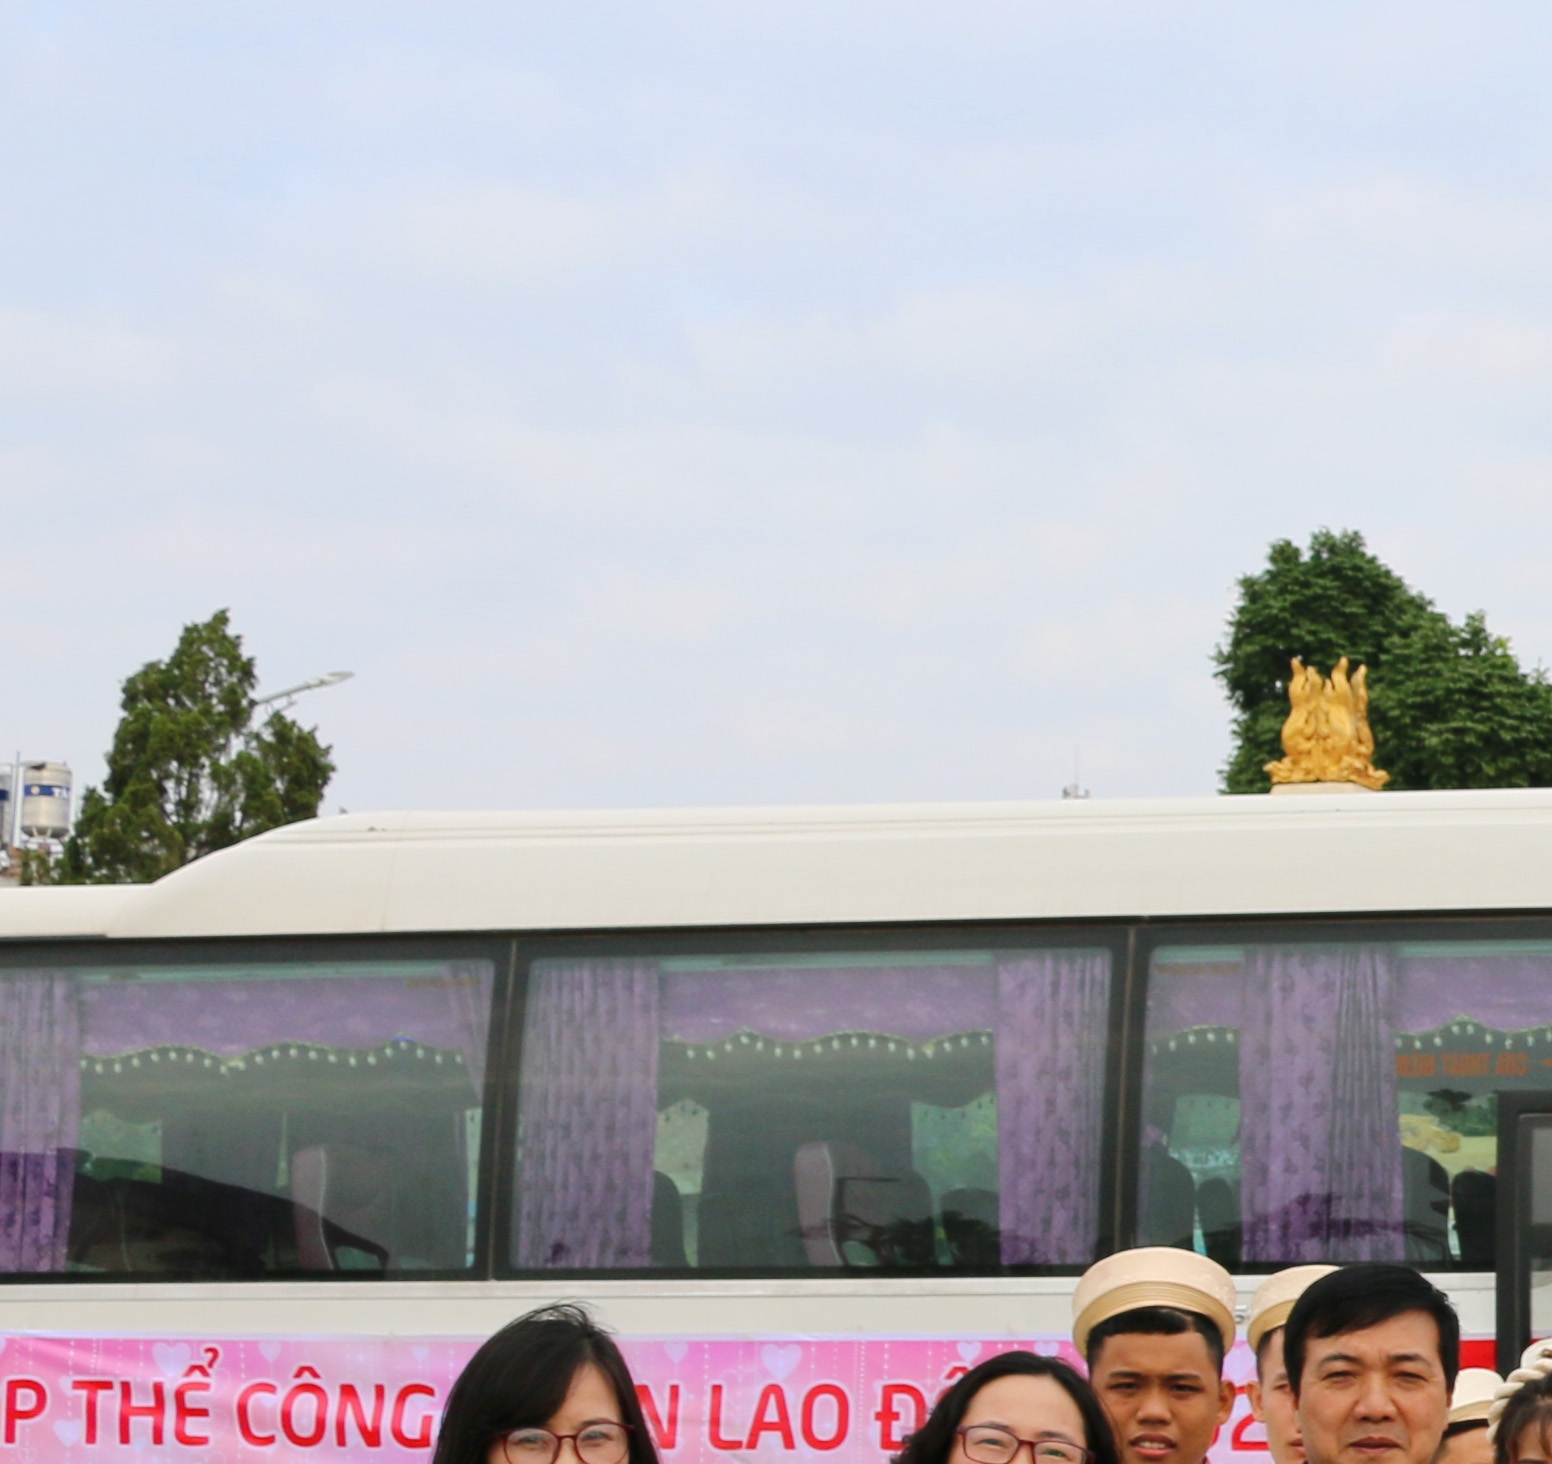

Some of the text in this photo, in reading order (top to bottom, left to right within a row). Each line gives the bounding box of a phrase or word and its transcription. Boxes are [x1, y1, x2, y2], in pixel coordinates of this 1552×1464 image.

[72, 1346, 219, 1447] THỂ
[237, 1366, 436, 1449] CÔNG
[708, 1383, 850, 1451] LAO
